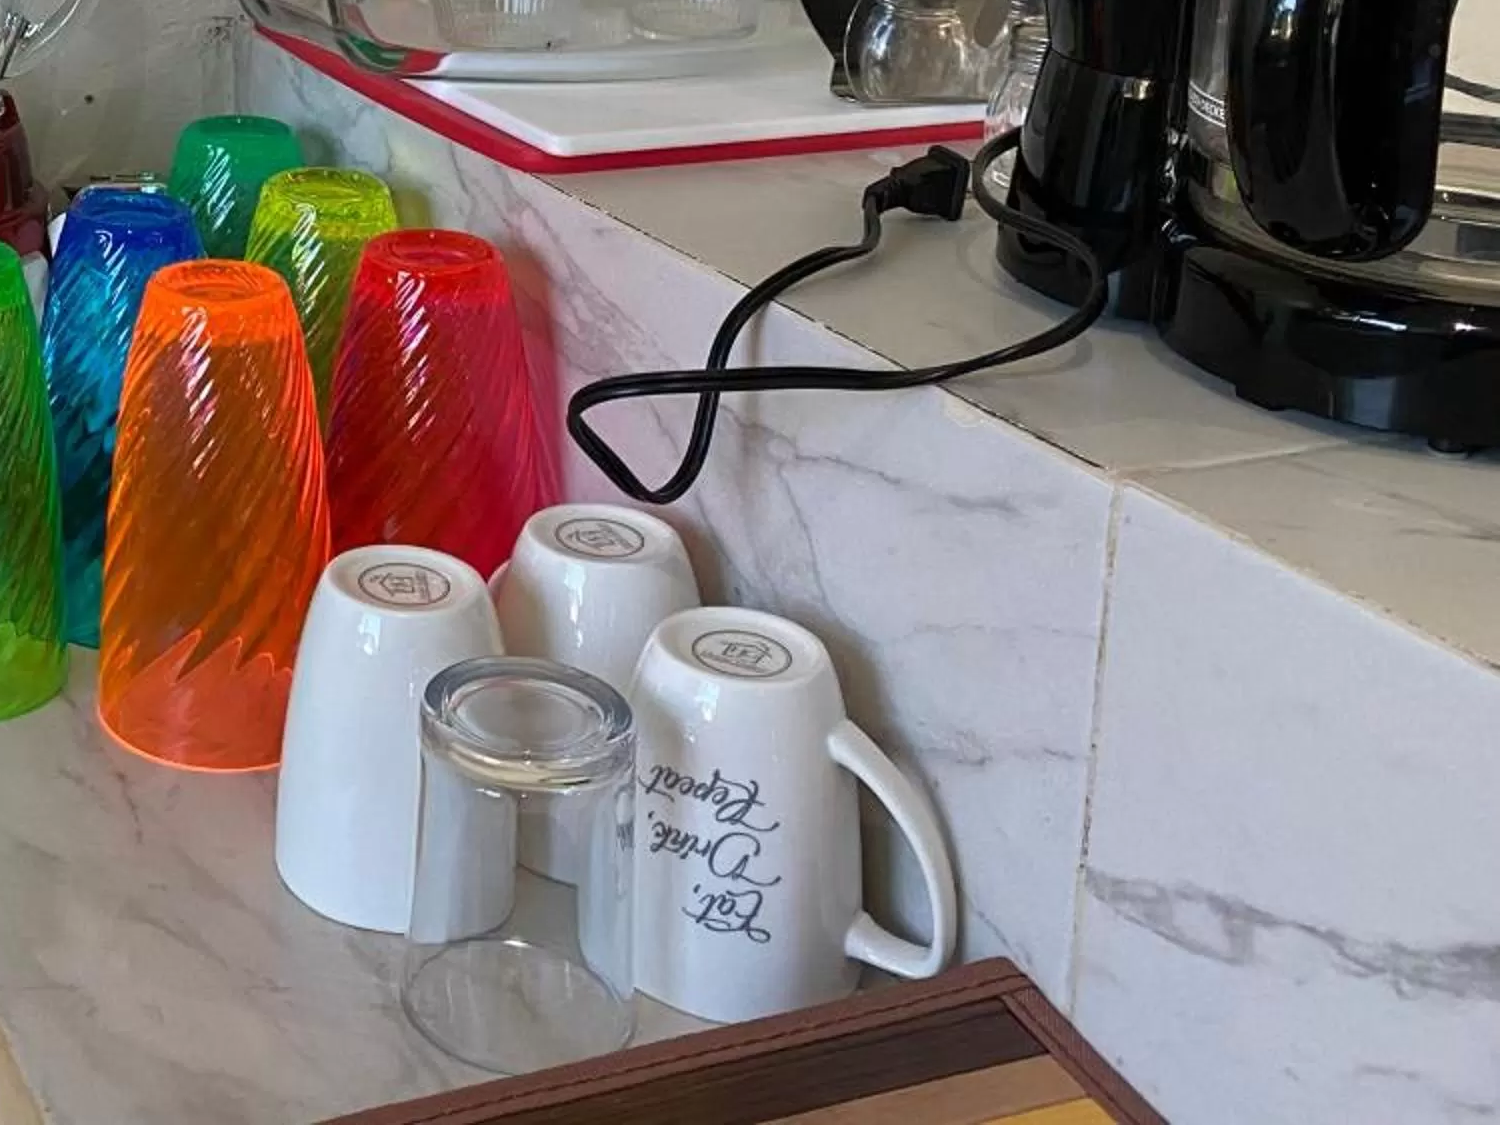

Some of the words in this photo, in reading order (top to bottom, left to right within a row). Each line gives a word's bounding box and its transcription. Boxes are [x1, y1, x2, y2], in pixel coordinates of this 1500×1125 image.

[637, 764, 780, 832] Repeat
[647, 811, 782, 886] Drink,
[681, 884, 772, 944] Eat,
